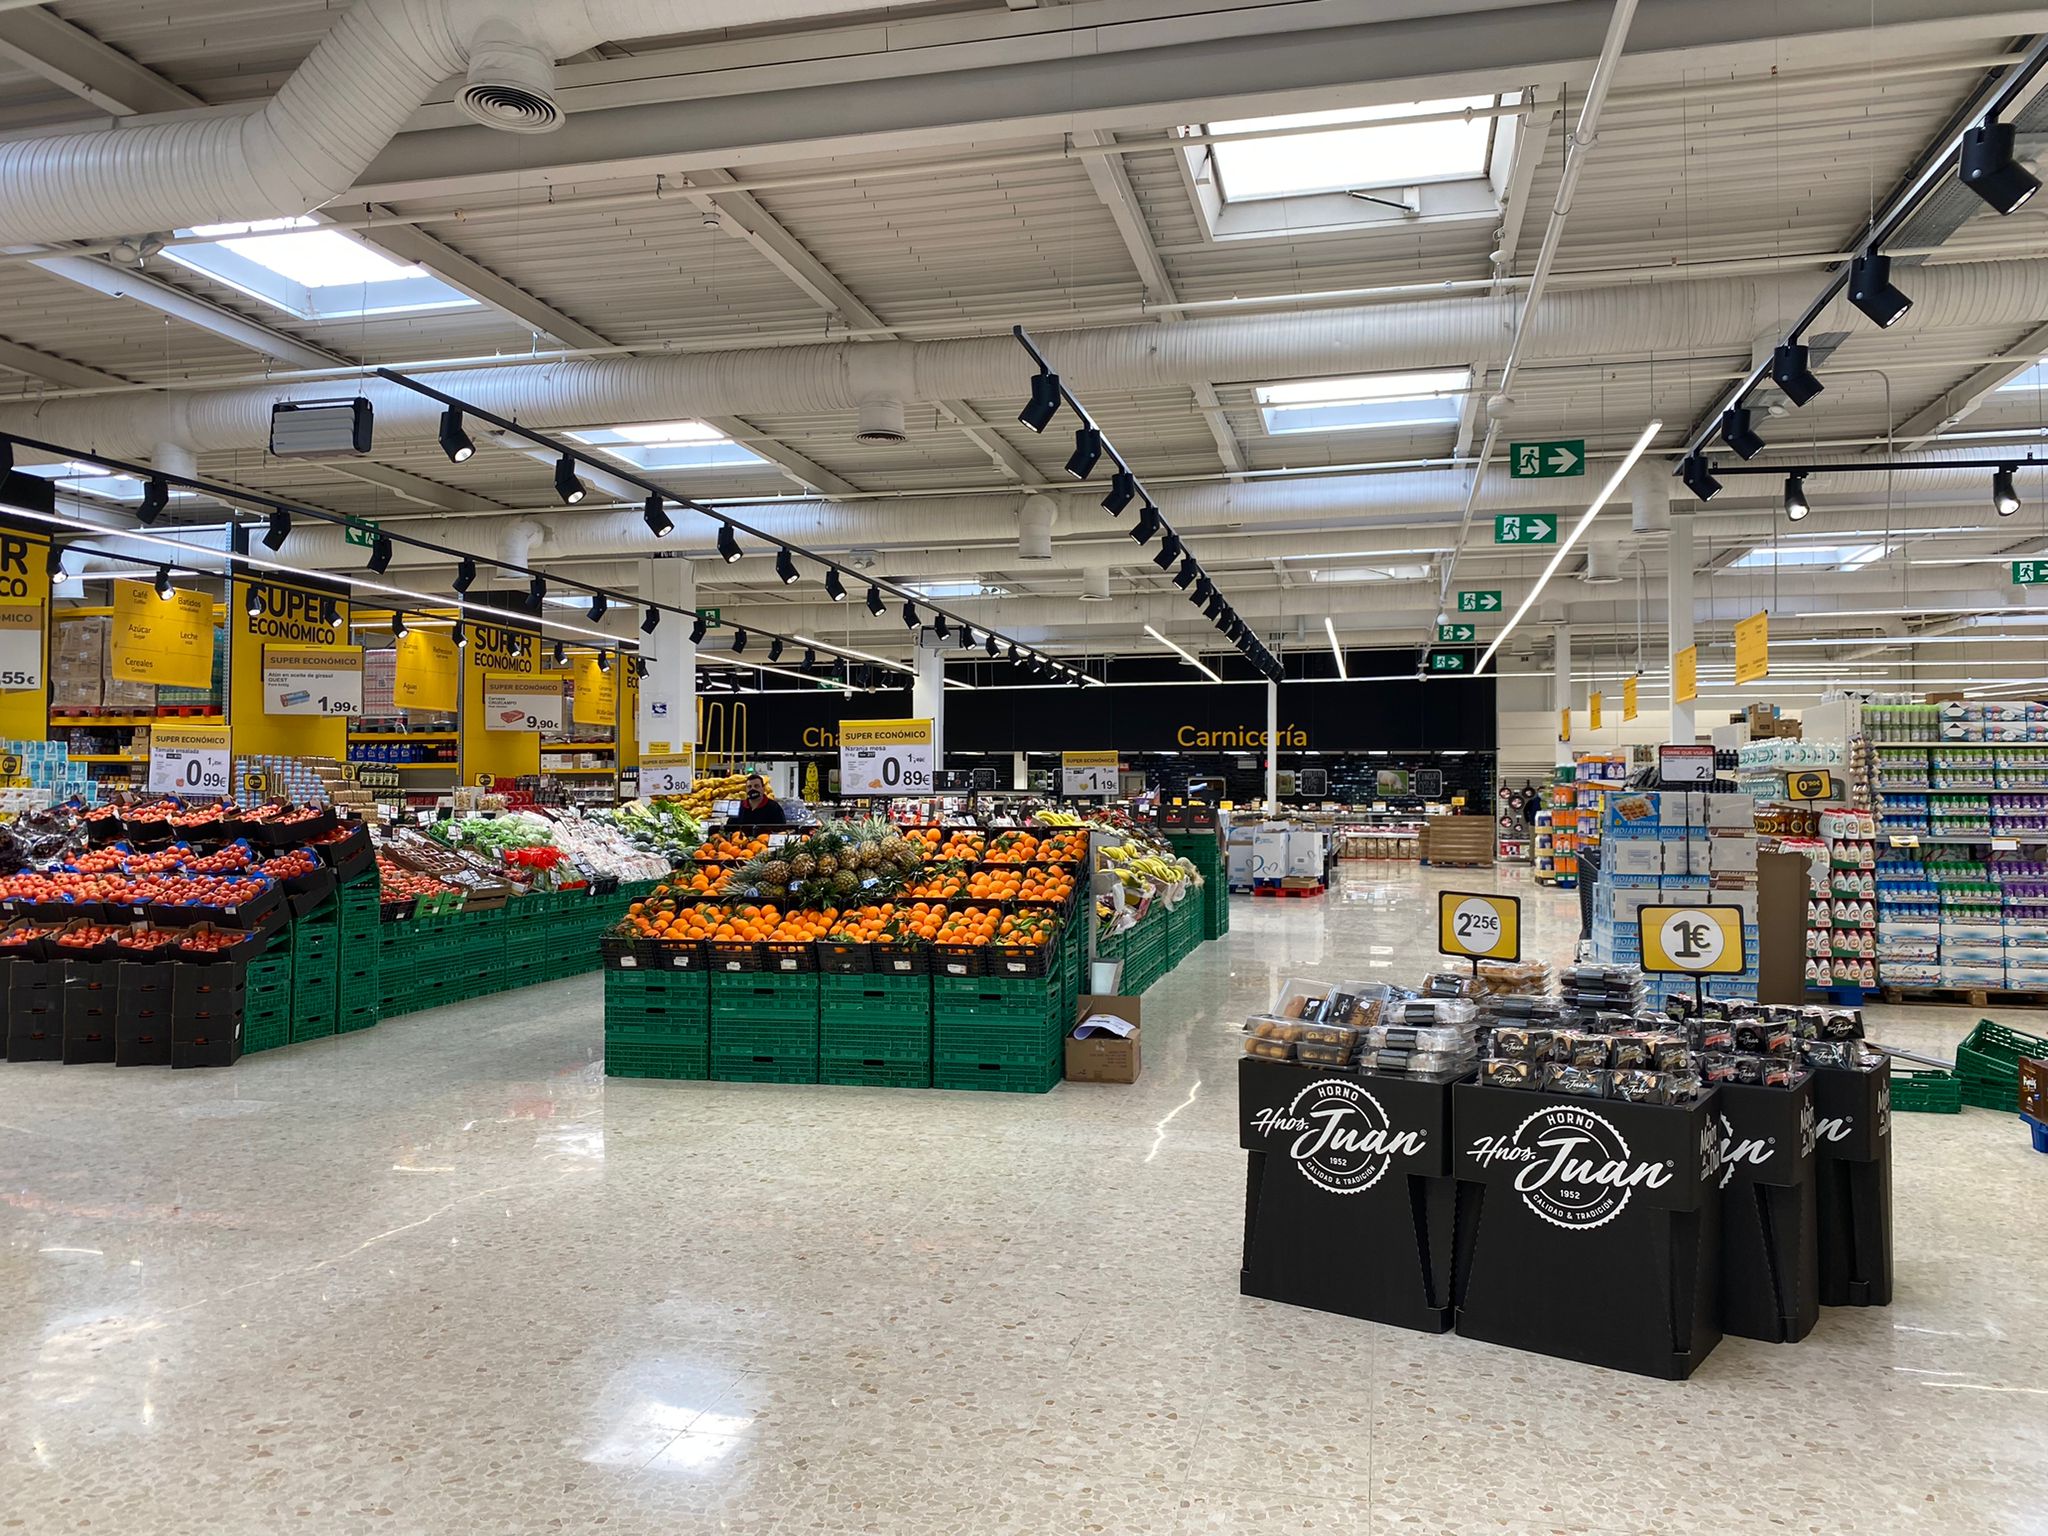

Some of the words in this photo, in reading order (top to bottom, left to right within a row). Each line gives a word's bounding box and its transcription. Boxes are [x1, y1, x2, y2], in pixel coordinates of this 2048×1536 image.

[132, 589, 149, 599] Café
[128, 624, 151, 633] Azúcar
[248, 616, 335, 645] ECONÓMICO
[180, 632, 198, 640] Leche
[125, 657, 153, 668] Cereales
[303, 656, 357, 666] ECONÓMICO
[474, 652, 532, 673] ECONÓMICO
[156, 735, 180, 744] SUPER
[181, 735, 225, 744] ECONÓMICO
[845, 732, 873, 740] SUPER
[875, 730, 926, 739] ECONÓMICO
[1177, 723, 1307, 747] Carnicería
[1614, 827, 1657, 835] HOJALDRES
[1664, 876, 1707, 884] HOJALDRES
[1672, 920, 1711, 957] 1€
[1712, 982, 1757, 992] HOJALDRES
[1318, 1086, 1359, 1101] HORNO
[1546, 1113, 1594, 1130] HORNO
[1250, 1107, 1310, 1138] Hnos.
[1290, 1108, 1427, 1160] Juan
[1329, 1157, 1347, 1166] 1952
[1467, 1136, 1537, 1168] Hnos.
[1514, 1137, 1673, 1192] Juan
[1306, 1161, 1333, 1183] CALIDAD
[1560, 1189, 1580, 1200] 1952
[1533, 1194, 1563, 1218] CALIDAD
[1566, 1211, 1573, 1219] &
